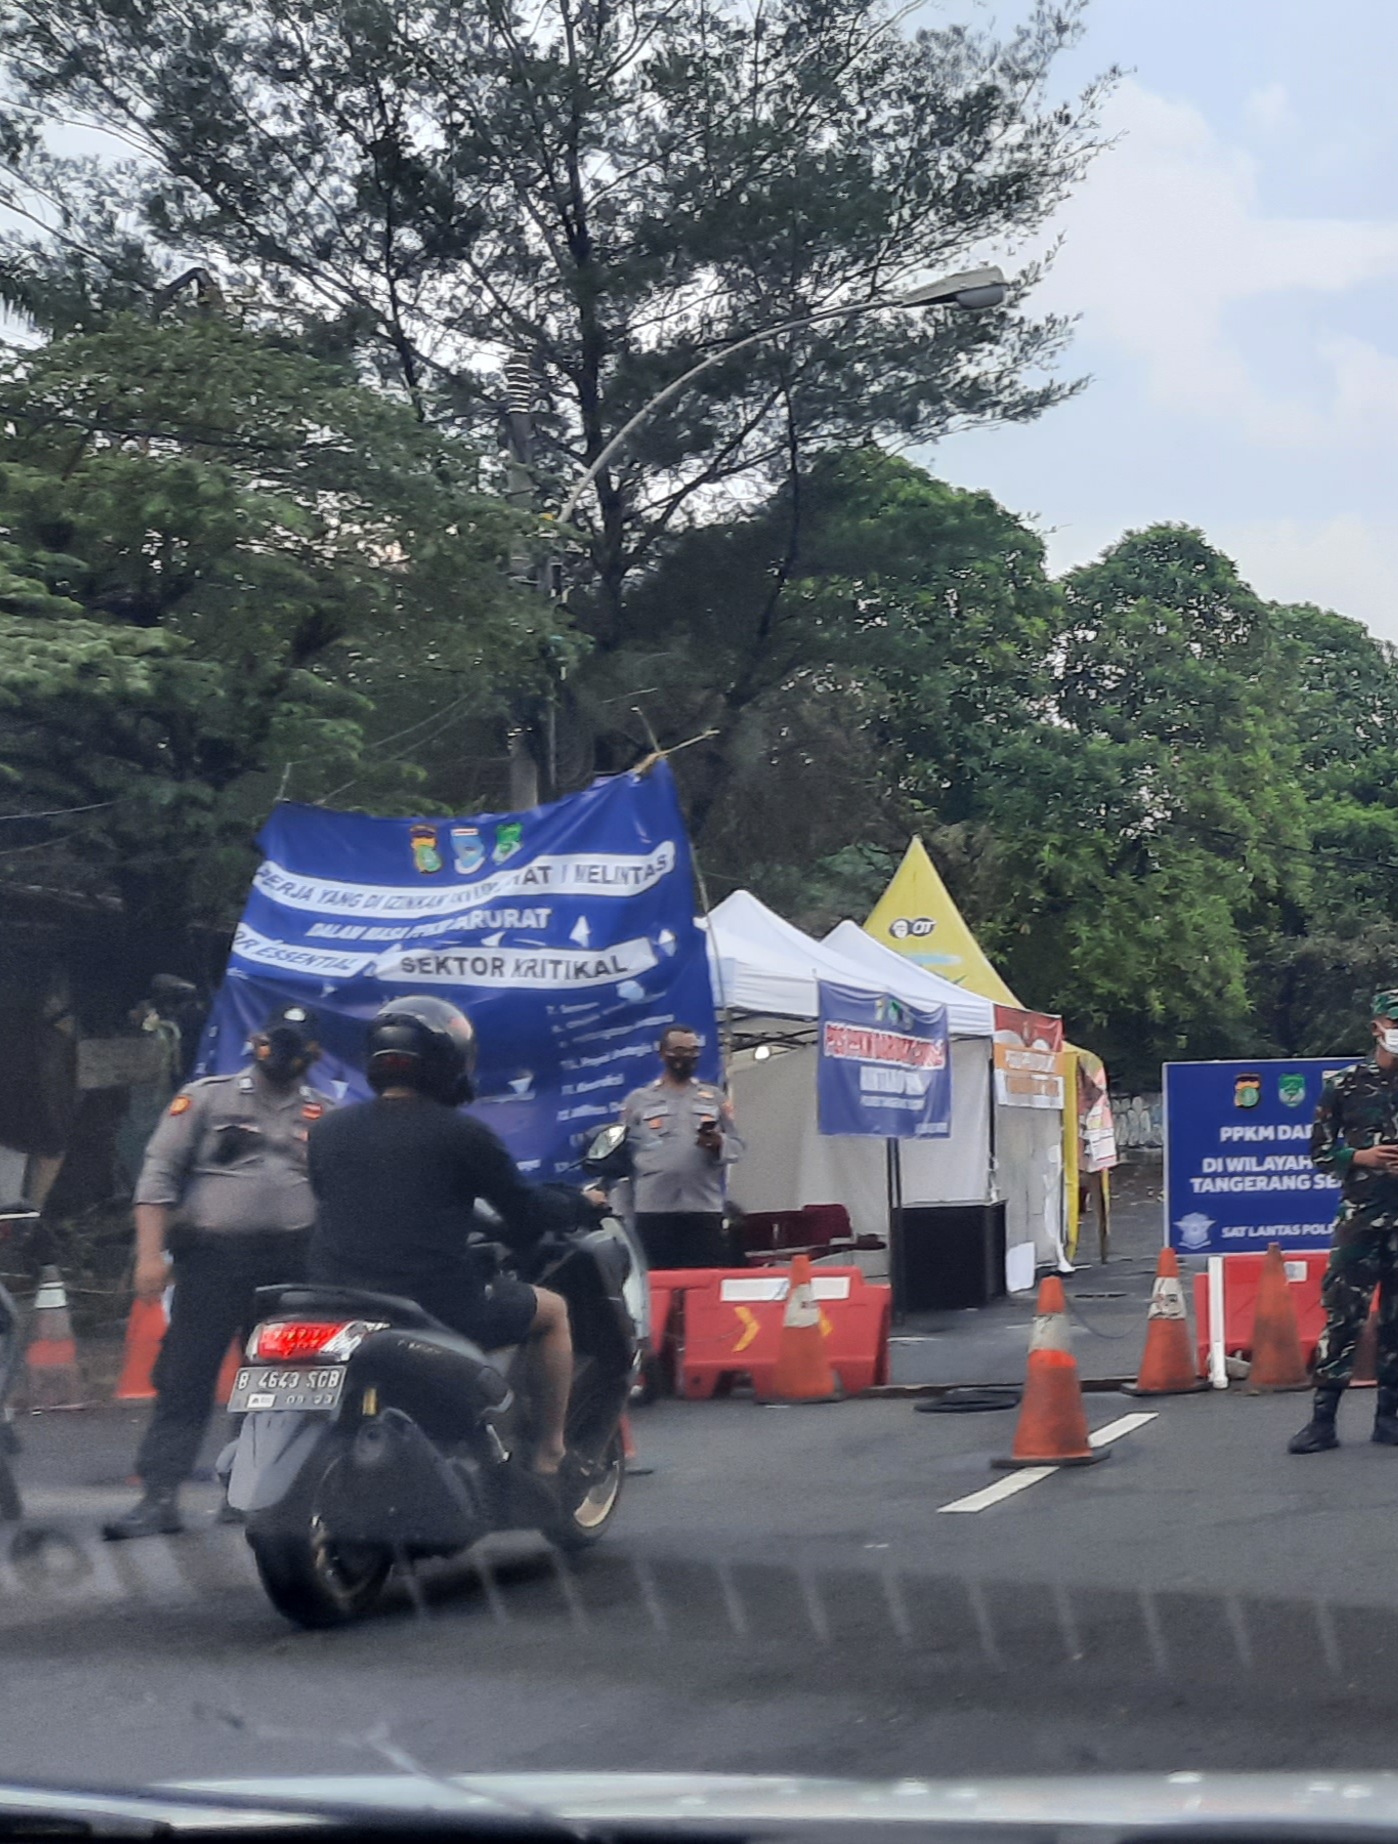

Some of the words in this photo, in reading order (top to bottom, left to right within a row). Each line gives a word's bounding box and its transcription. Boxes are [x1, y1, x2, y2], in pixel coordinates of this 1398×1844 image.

[401, 956, 506, 978] SEKTOR
[511, 955, 629, 980] KRITIKAL
[1220, 1126, 1276, 1142] PPKM
[1202, 1157, 1223, 1173] DI
[1225, 1155, 1313, 1172] WILAYAH
[1190, 1175, 1312, 1193] TANGERANG
[1221, 1226, 1246, 1238] SAT
[1247, 1224, 1301, 1237] LANTAS
[238, 1372, 250, 1390] B
[258, 1371, 300, 1389] 4643
